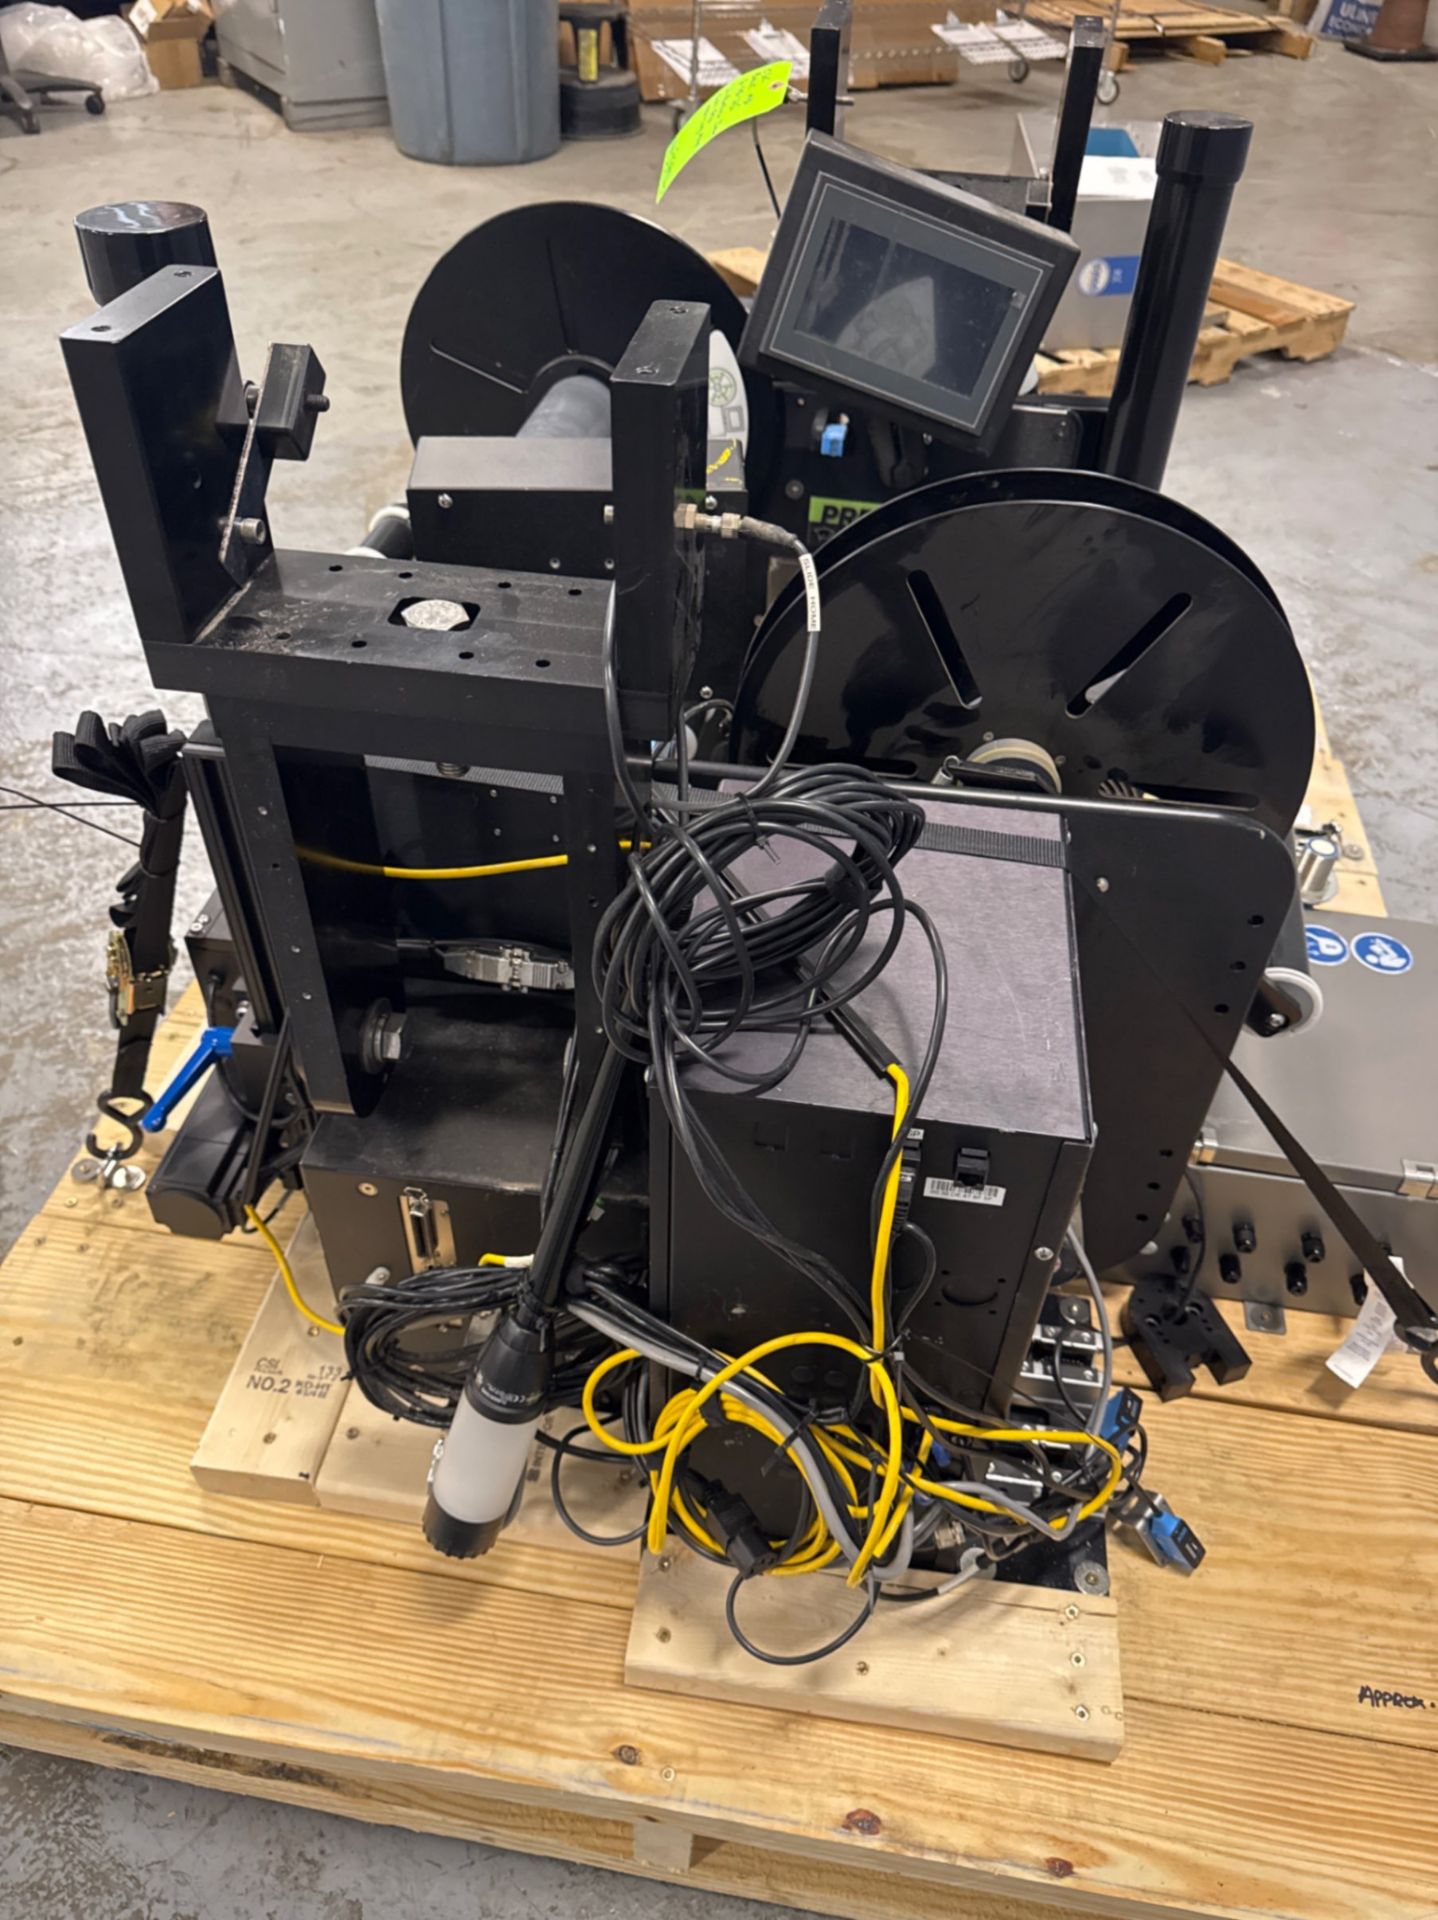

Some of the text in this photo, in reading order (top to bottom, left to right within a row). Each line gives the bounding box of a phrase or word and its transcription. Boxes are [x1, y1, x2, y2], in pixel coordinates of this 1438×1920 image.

[802, 558, 818, 629] SLIDE HOME
[246, 1374, 292, 1395] NO.2
